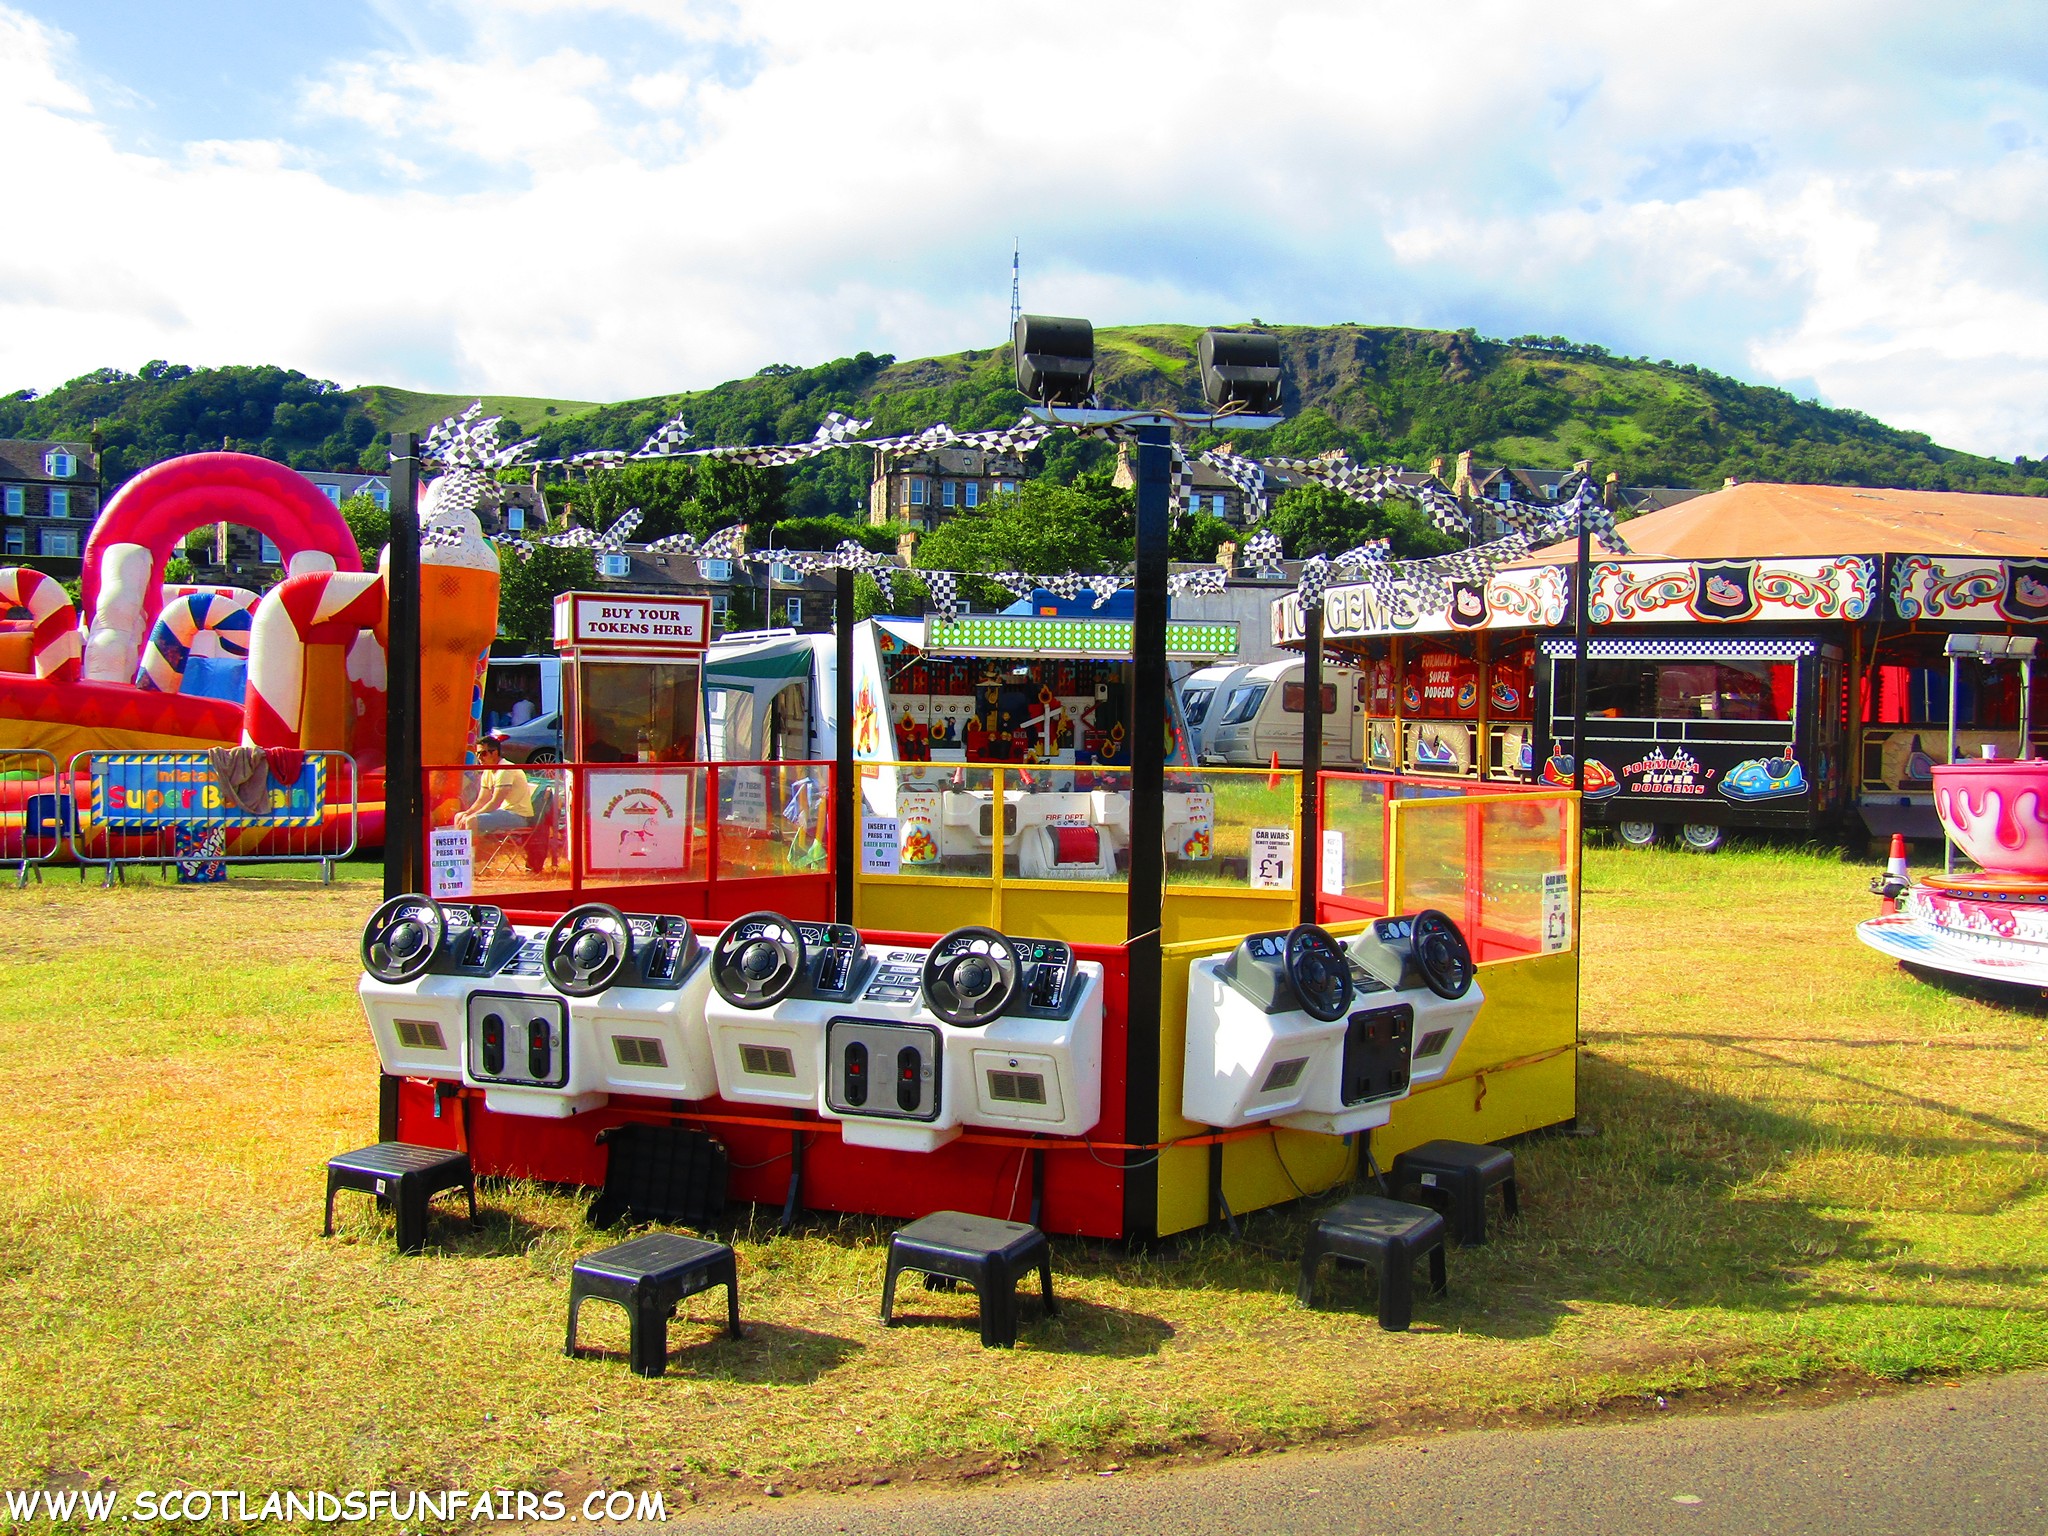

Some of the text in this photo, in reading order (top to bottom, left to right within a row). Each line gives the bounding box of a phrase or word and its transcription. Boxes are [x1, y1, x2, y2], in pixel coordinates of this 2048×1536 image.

[602, 607, 680, 621] BUY YOUR
[588, 622, 693, 636] TOKENS HERE
[1429, 671, 1450, 683] SUPER
[1424, 686, 1455, 698] DODGEMS
[1622, 759, 1715, 779] FORMULA 1
[1642, 774, 1694, 784] SUPER
[1631, 783, 1705, 794] DODGEMS
[108, 785, 197, 813] Super
[624, 788, 674, 819] Amusements
[435, 838, 458, 846] INSERT
[1256, 831, 1290, 840] CAR WARS
[1259, 859, 1284, 878] £1
[1548, 912, 1566, 939] £1
